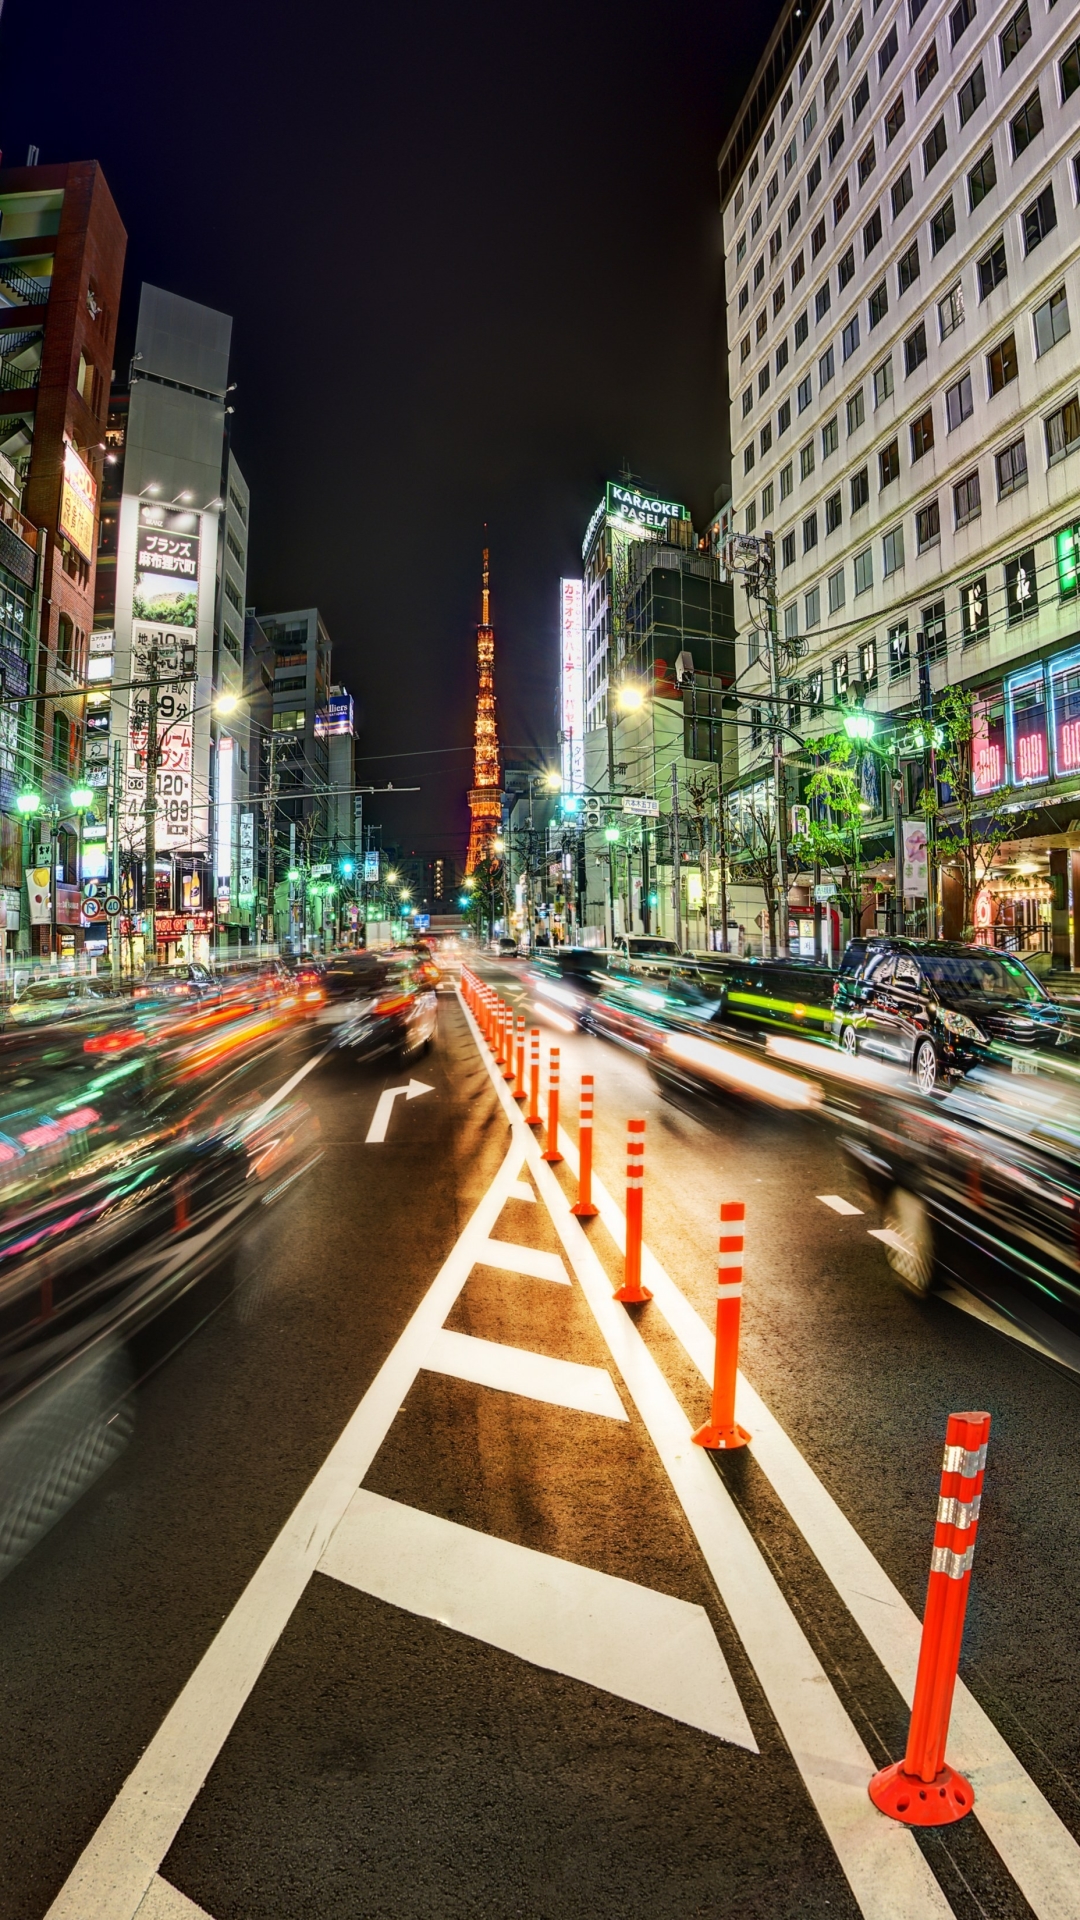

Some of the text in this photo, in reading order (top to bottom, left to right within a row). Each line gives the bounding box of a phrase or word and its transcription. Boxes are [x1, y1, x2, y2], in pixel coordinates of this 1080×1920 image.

[613, 486, 679, 517] KARAOKE
[620, 504, 668, 528] PASELA
[145, 536, 192, 558] ブランズ
[107, 901, 119, 911] 40
